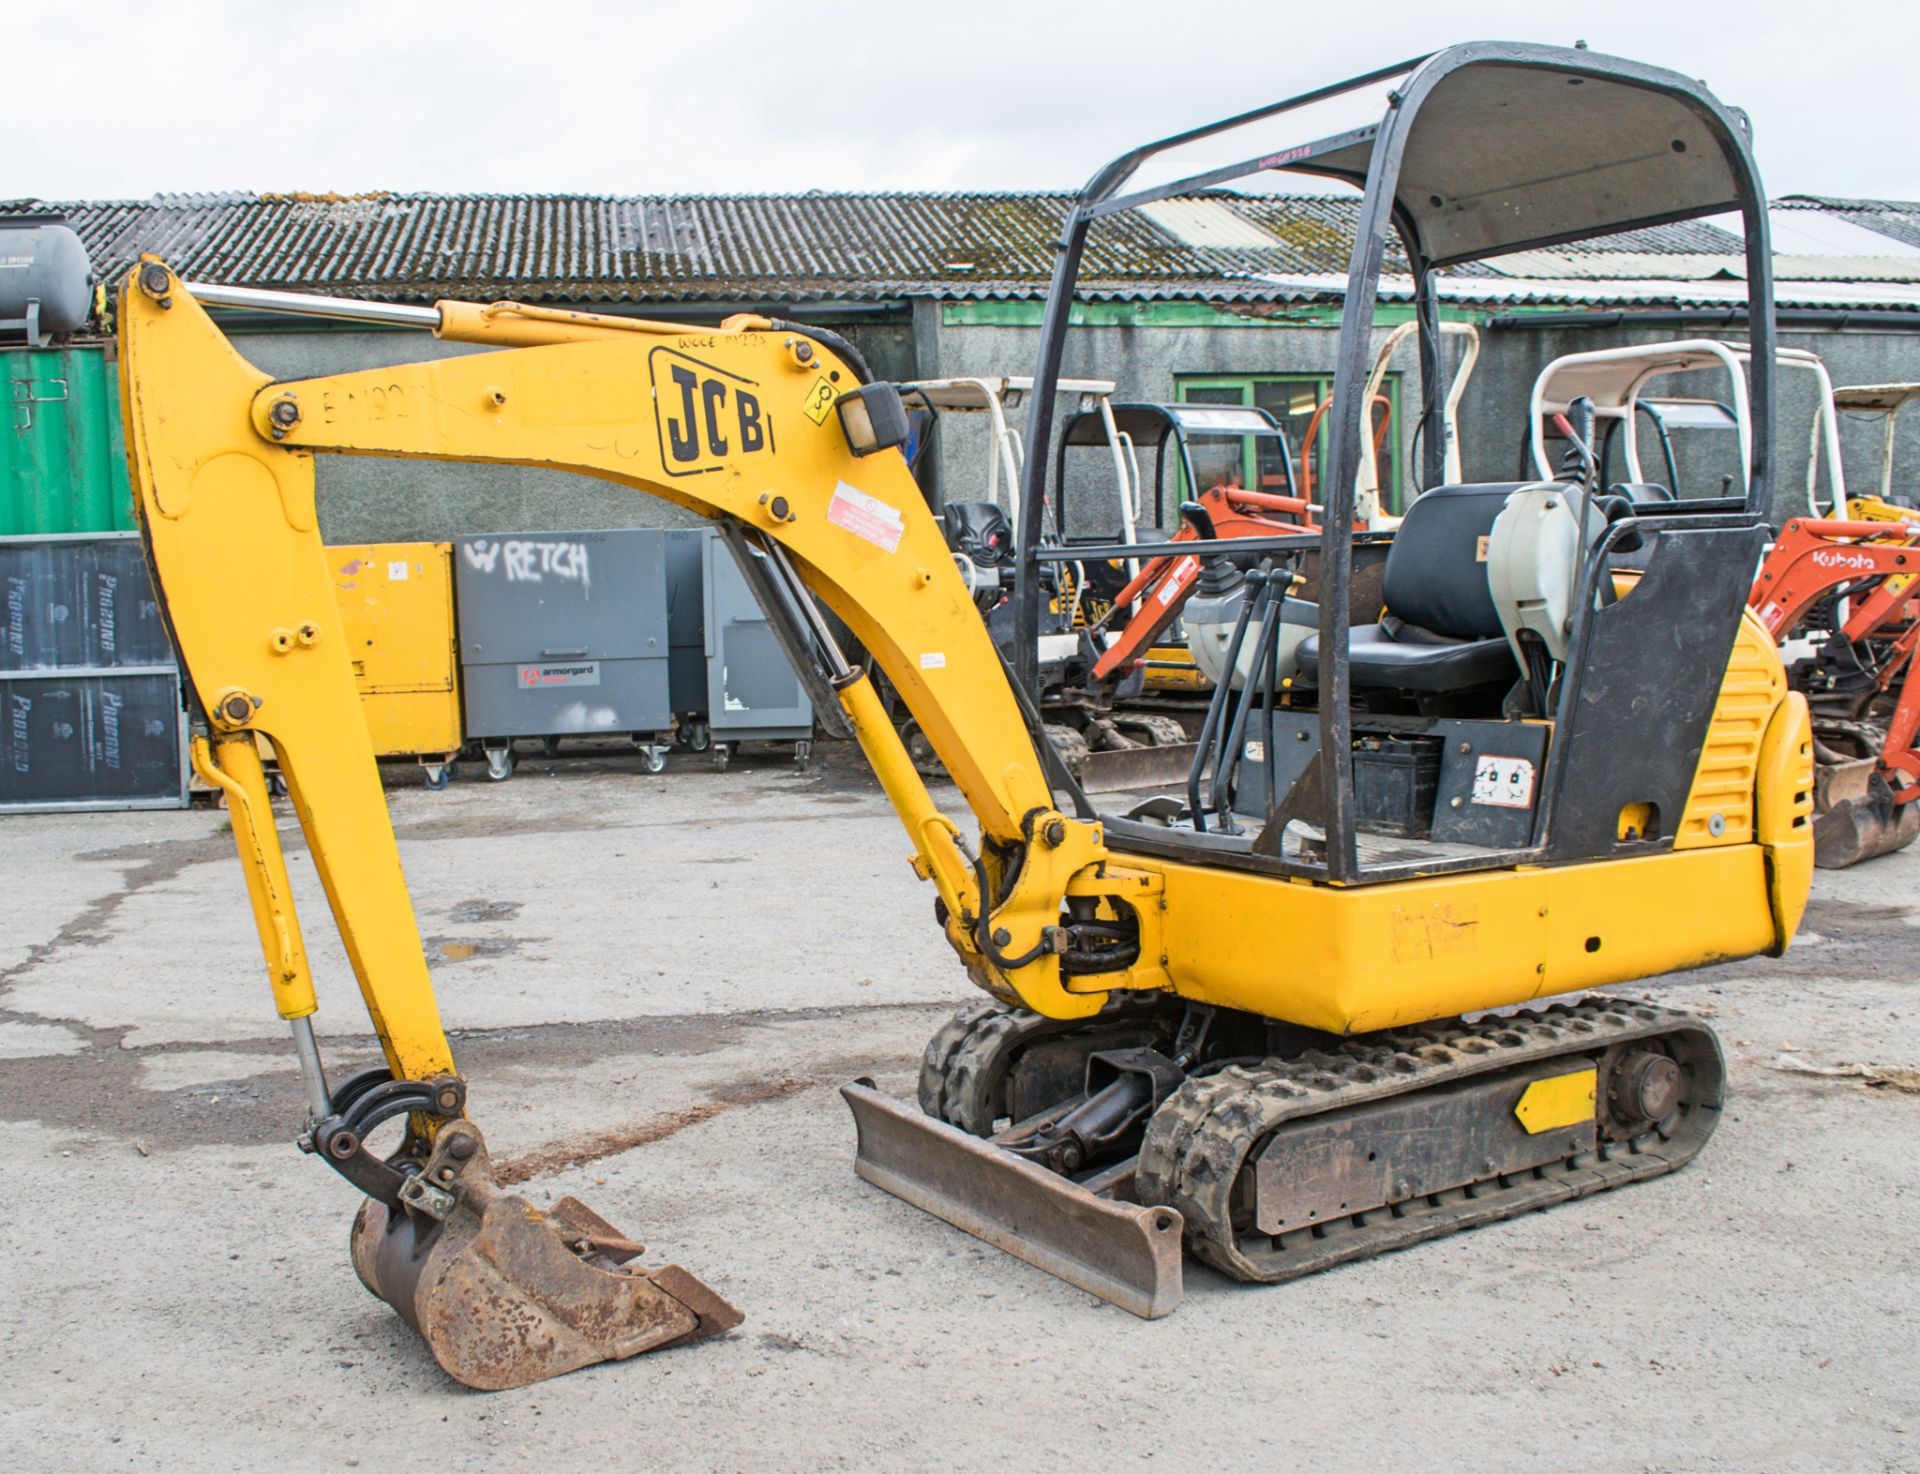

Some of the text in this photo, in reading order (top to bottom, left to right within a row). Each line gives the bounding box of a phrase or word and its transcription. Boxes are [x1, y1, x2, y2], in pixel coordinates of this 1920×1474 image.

[667, 363, 764, 462] JCB
[1812, 551, 1875, 569] Kubota
[543, 665, 593, 676] armorgard
